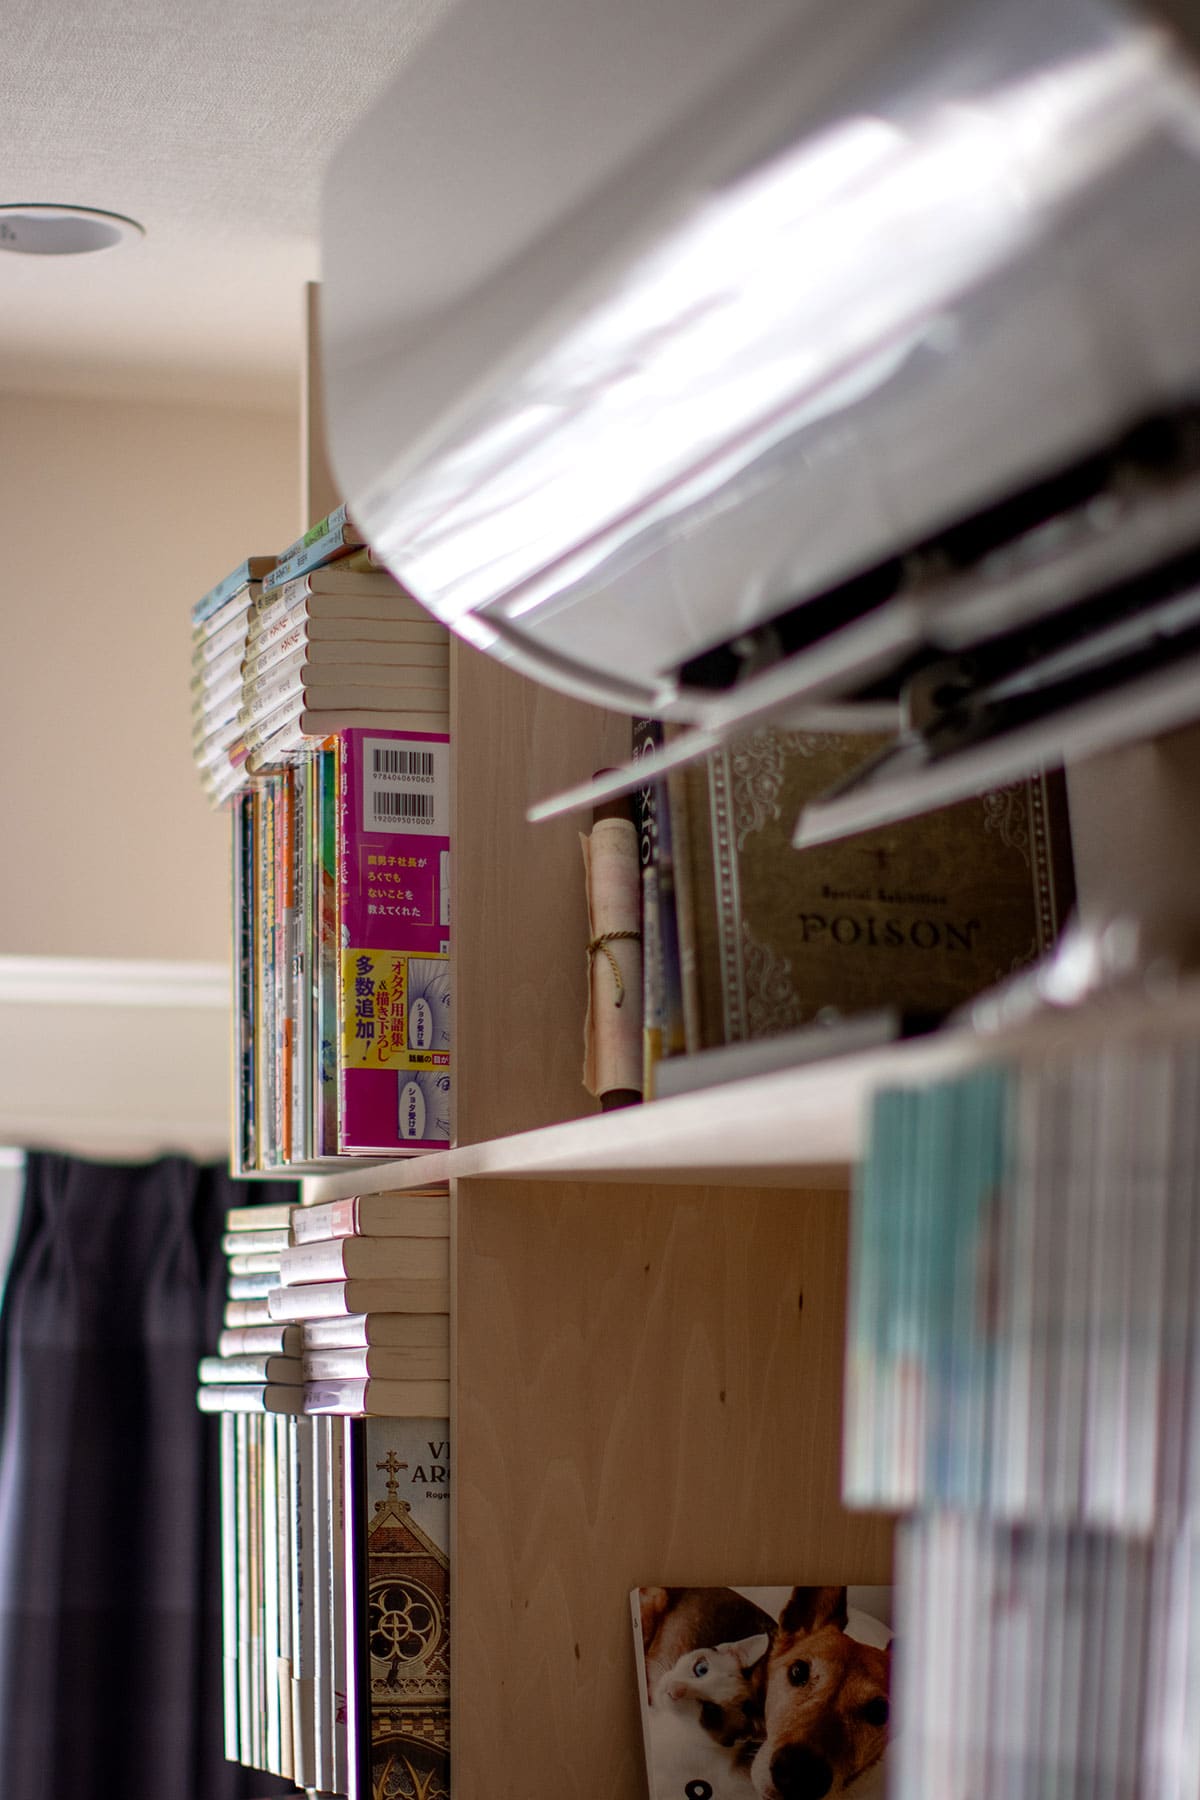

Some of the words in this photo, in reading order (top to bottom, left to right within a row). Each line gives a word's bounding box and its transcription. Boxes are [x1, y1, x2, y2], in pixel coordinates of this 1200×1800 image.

[373, 773, 435, 783] 9784040690605
[374, 815, 435, 825] 1920095010007
[368, 871, 401, 883] ろくでも
[368, 888, 413, 900] ないことを
[368, 904, 421, 917] 教えてくれた
[799, 912, 981, 951] POISON
[411, 1465, 450, 1483] AR
